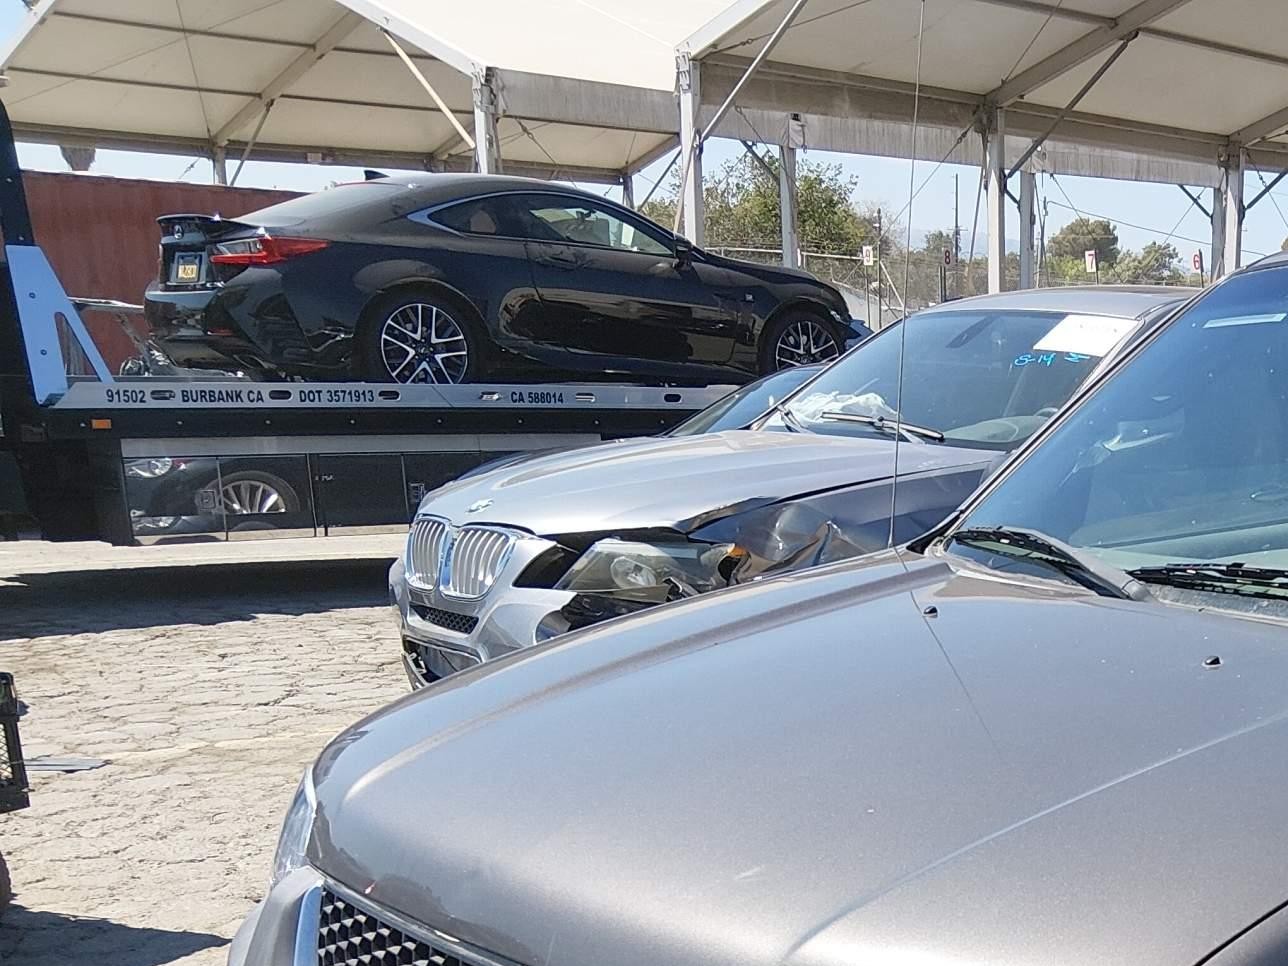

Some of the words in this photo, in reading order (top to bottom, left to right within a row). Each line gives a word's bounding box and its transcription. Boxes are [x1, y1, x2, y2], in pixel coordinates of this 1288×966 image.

[944, 249, 951, 265] 8
[1193, 254, 1200, 270] 6
[106, 389, 147, 404] 91502
[181, 389, 244, 403] BURBANK
[248, 390, 264, 404] CA
[299, 389, 323, 403] DOT
[326, 389, 375, 403] 3571913
[510, 391, 525, 404] CA
[527, 391, 564, 404] 588014
